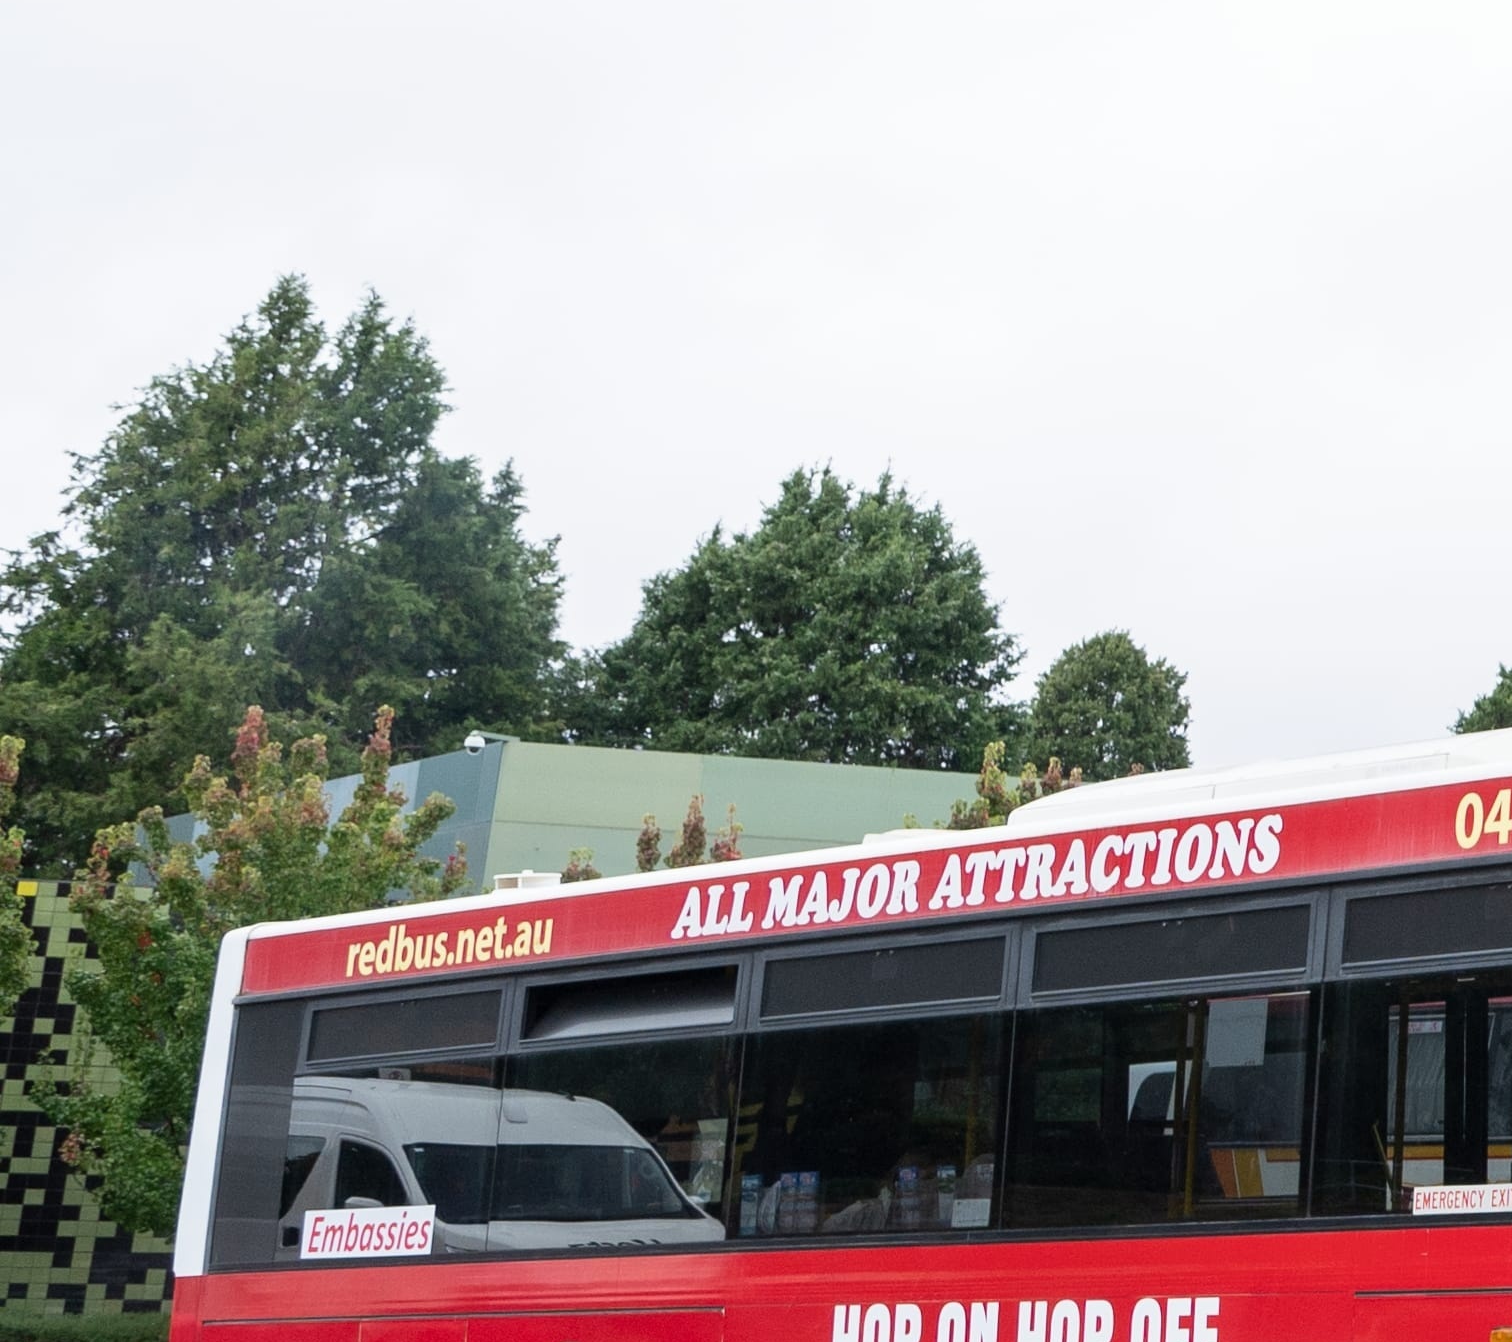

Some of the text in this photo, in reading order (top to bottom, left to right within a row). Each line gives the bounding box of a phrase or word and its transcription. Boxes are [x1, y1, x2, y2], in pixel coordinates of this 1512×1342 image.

[671, 814, 1283, 939] ALL MAJOR ATTRACTIONS
[346, 916, 554, 977] redbus.net.au
[1415, 1190, 1484, 1209] EMERGENCY
[308, 1211, 431, 1253] Embassies
